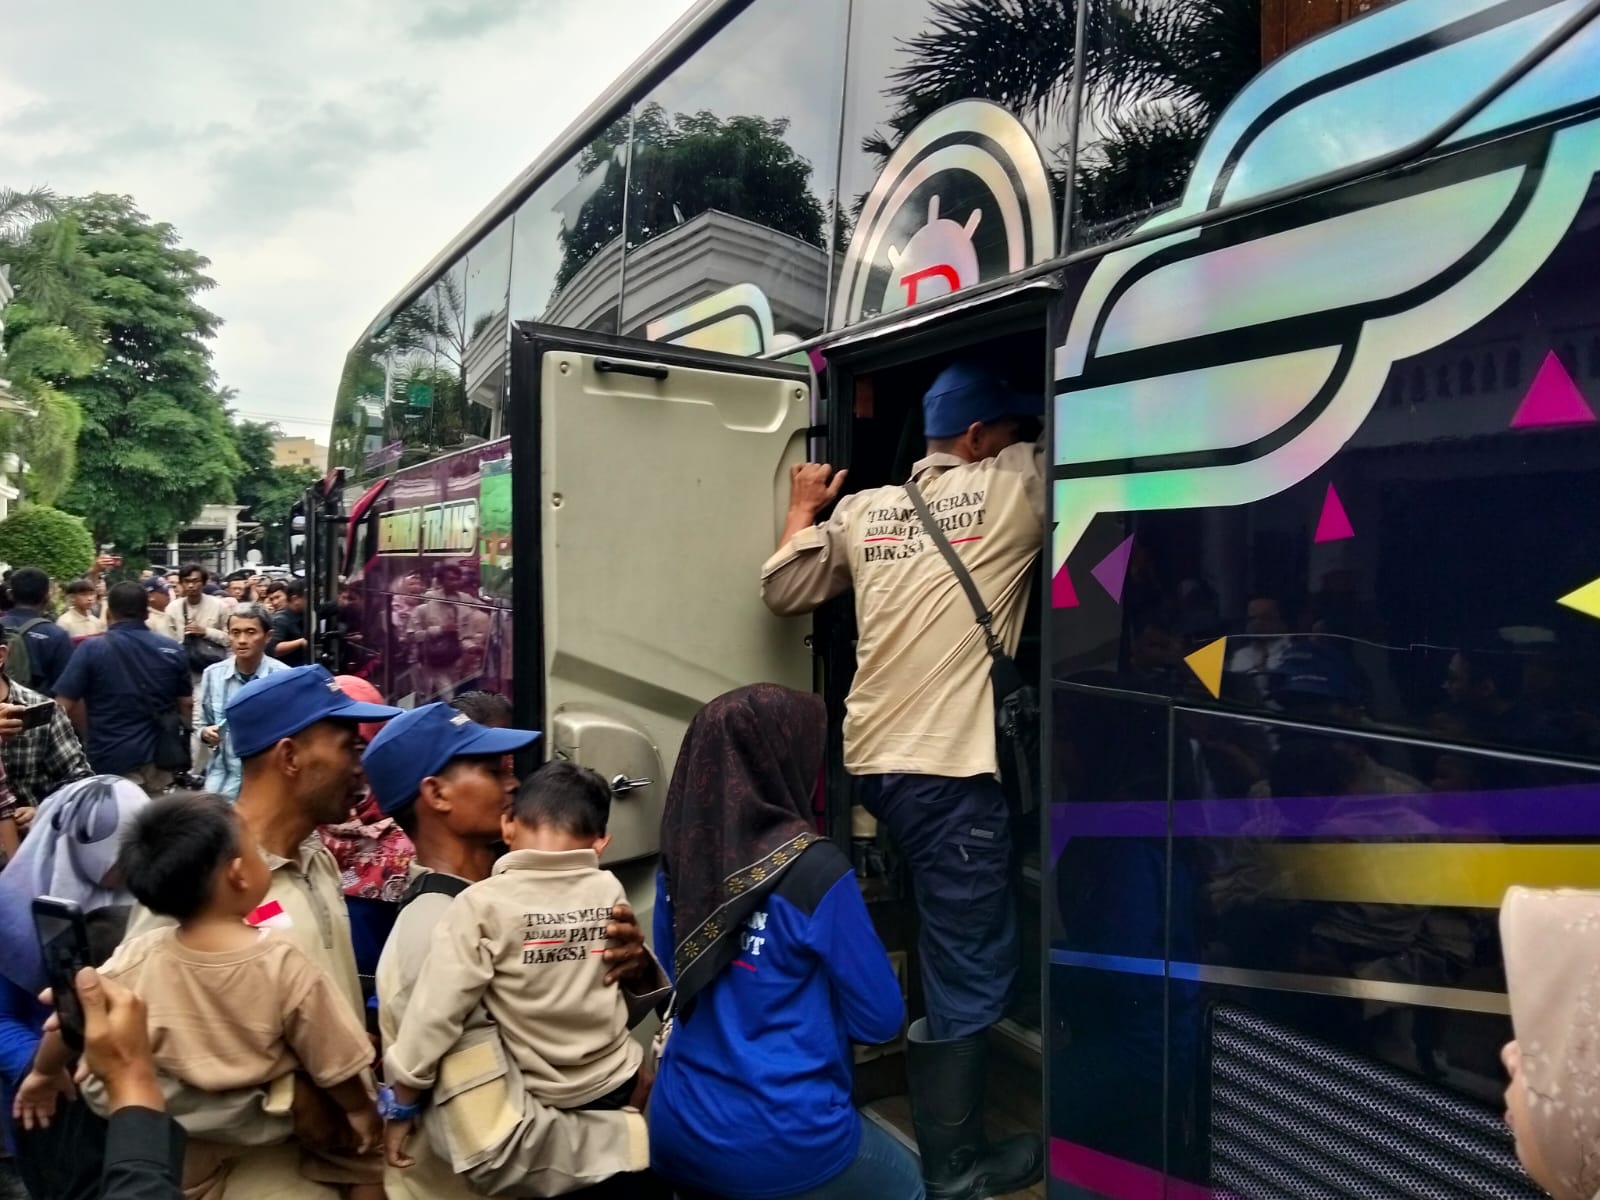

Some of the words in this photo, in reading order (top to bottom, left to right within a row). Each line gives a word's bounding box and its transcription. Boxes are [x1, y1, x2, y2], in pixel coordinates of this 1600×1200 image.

[868, 491, 984, 523] TRANIGRAN
[866, 525, 907, 537] ADALAH
[908, 509, 986, 540] PRIOT
[523, 907, 614, 927] TRANSMIGR
[524, 929, 566, 941] ADALAH
[568, 926, 608, 942] PATR
[523, 946, 588, 964] BANGSA
